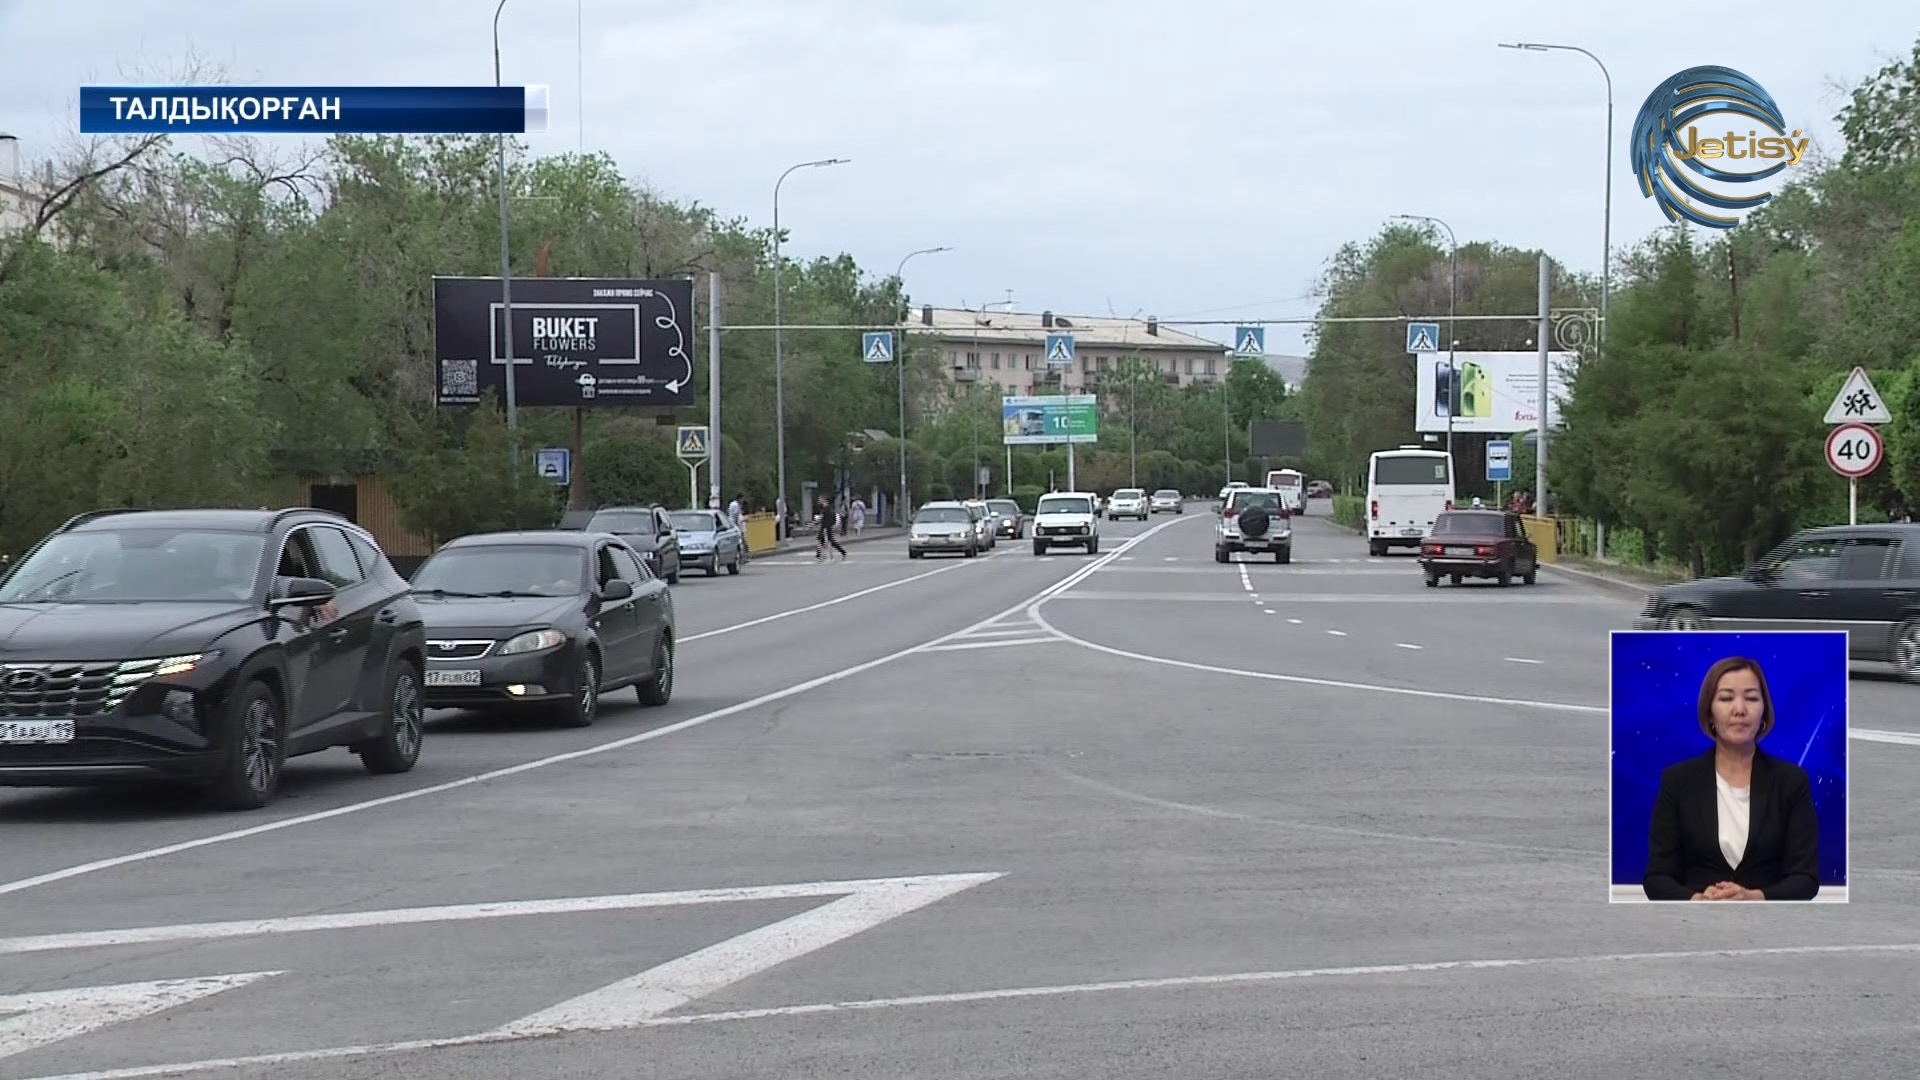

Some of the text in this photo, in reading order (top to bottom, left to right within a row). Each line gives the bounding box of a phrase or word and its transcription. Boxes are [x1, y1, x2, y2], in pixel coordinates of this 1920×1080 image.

[532, 317, 598, 338] BUKET
[533, 338, 597, 351] FLOWERS
[1837, 439, 1870, 460] 40
